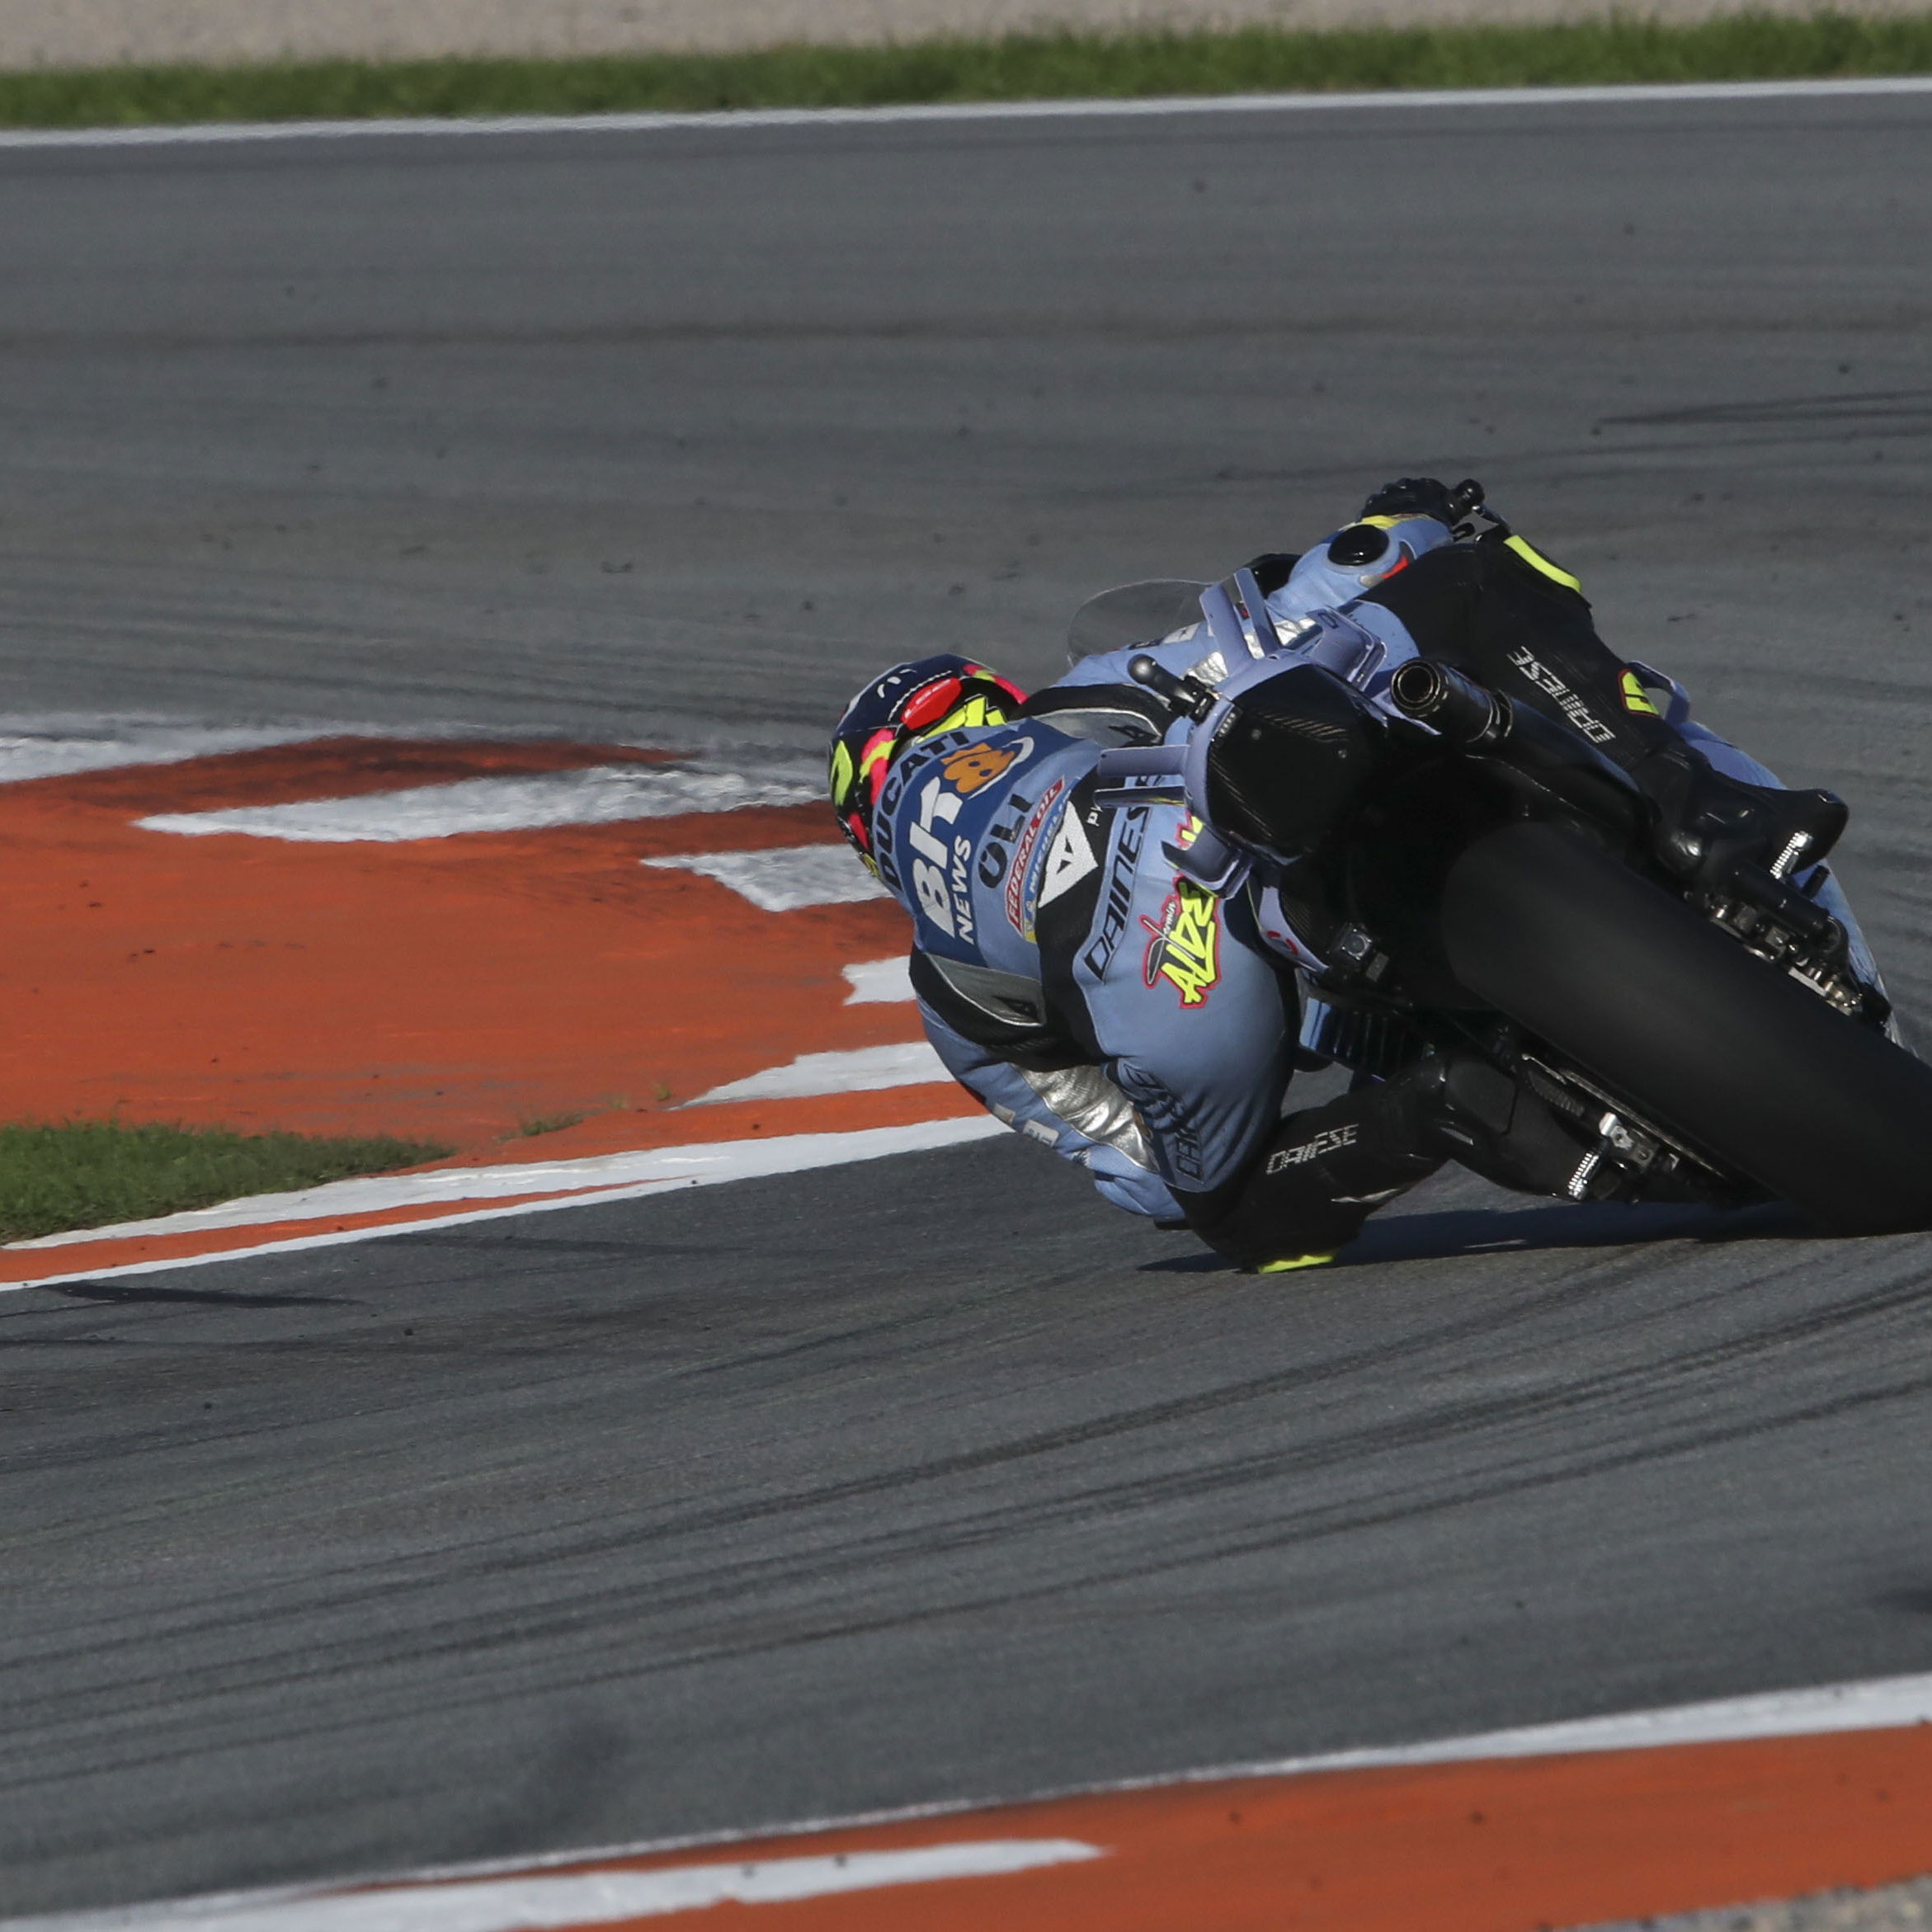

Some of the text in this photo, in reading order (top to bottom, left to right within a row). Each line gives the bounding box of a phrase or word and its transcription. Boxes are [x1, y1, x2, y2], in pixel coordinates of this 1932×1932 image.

[1506, 644, 1615, 742] DAINESE
[877, 732, 969, 891] DUCATI
[1008, 786, 1059, 921] FEDERAL OIL
[949, 835, 975, 946] NEWS
[1083, 775, 1162, 982] DAINES
[1265, 1124, 1359, 1175] DAINESE
